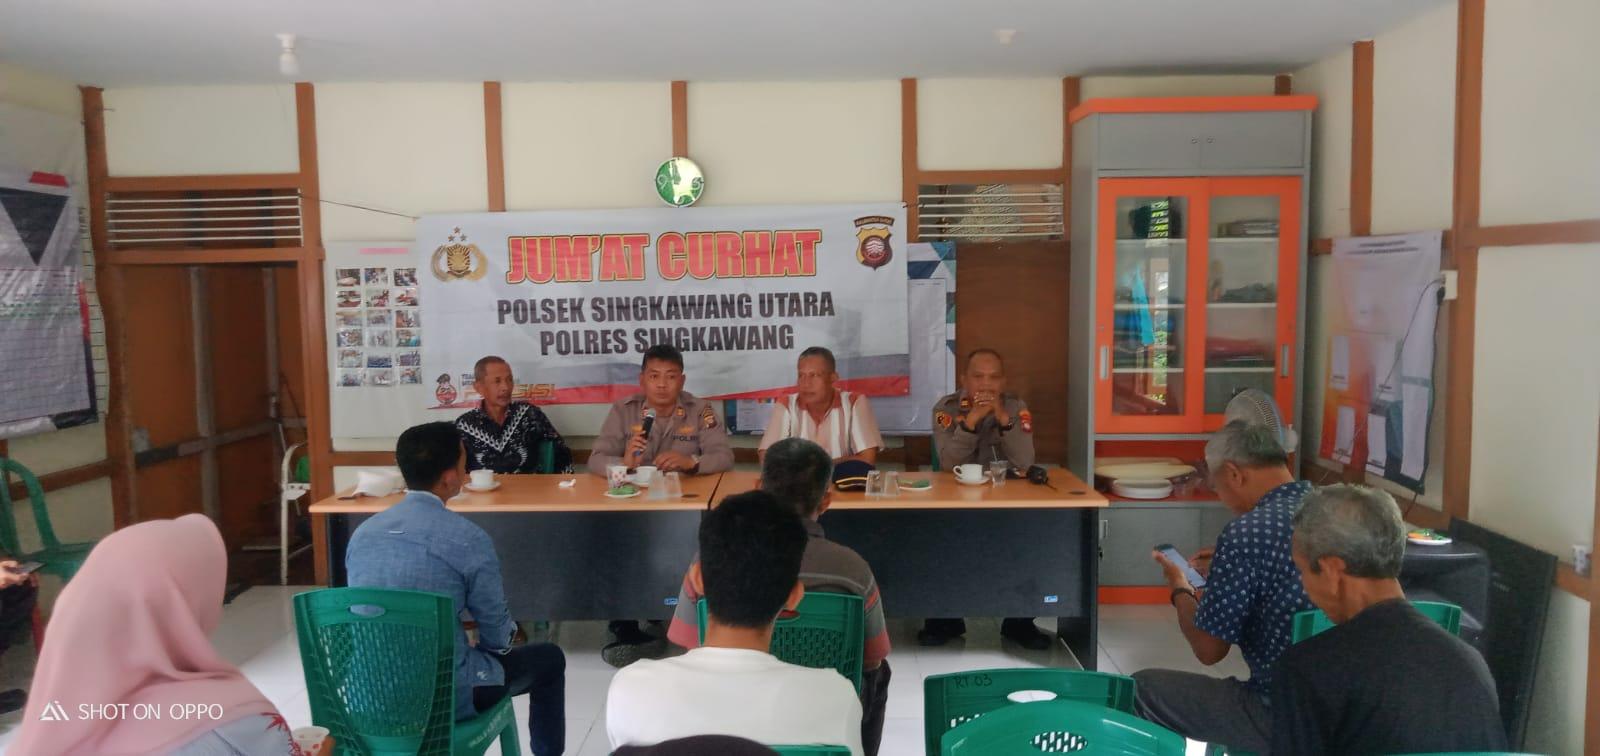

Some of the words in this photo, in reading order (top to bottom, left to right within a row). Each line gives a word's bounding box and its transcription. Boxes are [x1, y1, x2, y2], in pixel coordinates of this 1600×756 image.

[506, 233, 650, 284] JUM'AT
[657, 229, 822, 280] CURHAT
[498, 297, 586, 324] POLSEK
[592, 293, 752, 322] SINGKAWANG
[759, 291, 835, 318] UTARA
[540, 328, 628, 356] POLRES
[634, 324, 794, 354] SINGKAWANG
[954, 675, 969, 689] RT
[974, 674, 992, 687] 03
